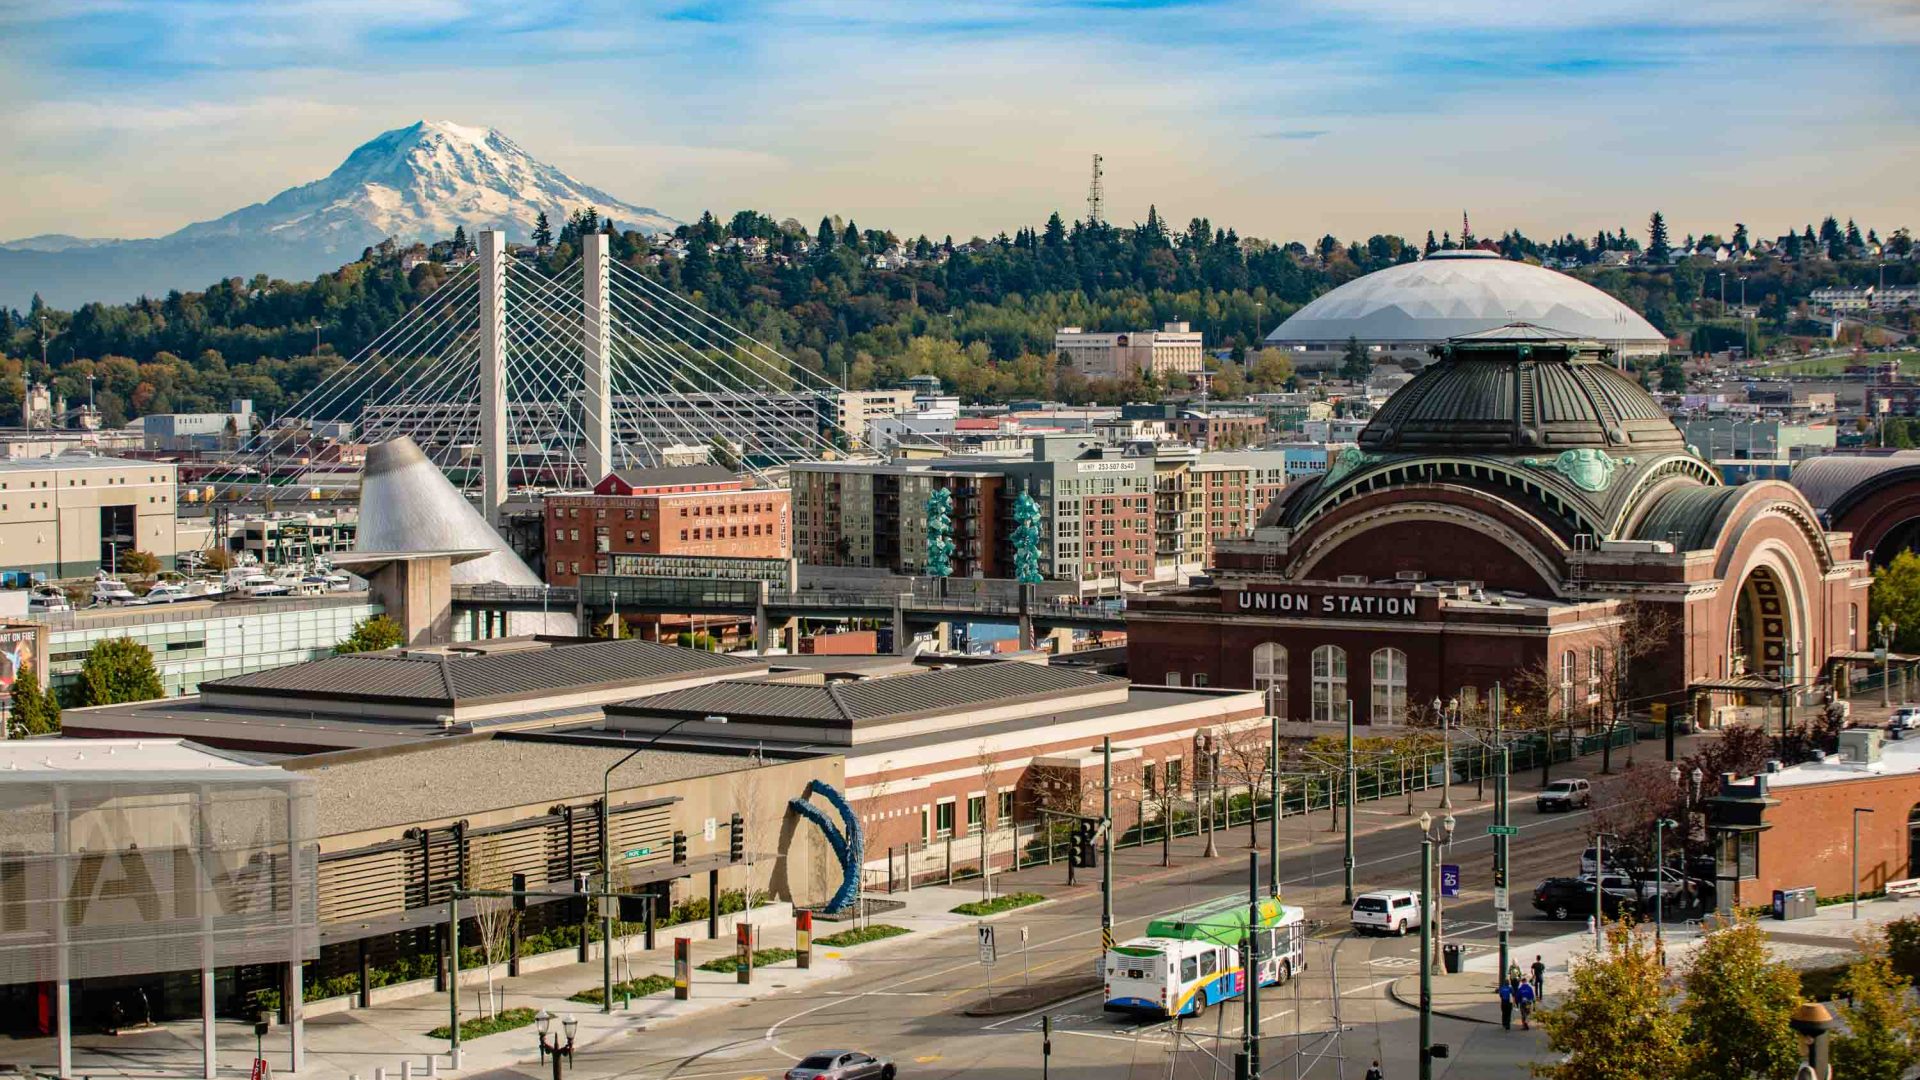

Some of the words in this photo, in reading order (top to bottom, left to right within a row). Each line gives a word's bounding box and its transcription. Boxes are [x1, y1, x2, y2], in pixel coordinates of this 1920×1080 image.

[1239, 592, 1309, 611] UNION
[1322, 595, 1416, 615] STATION
[12, 632, 20, 642] ON
[22, 631, 36, 641] FIRE
[1444, 873, 1457, 887] 25
